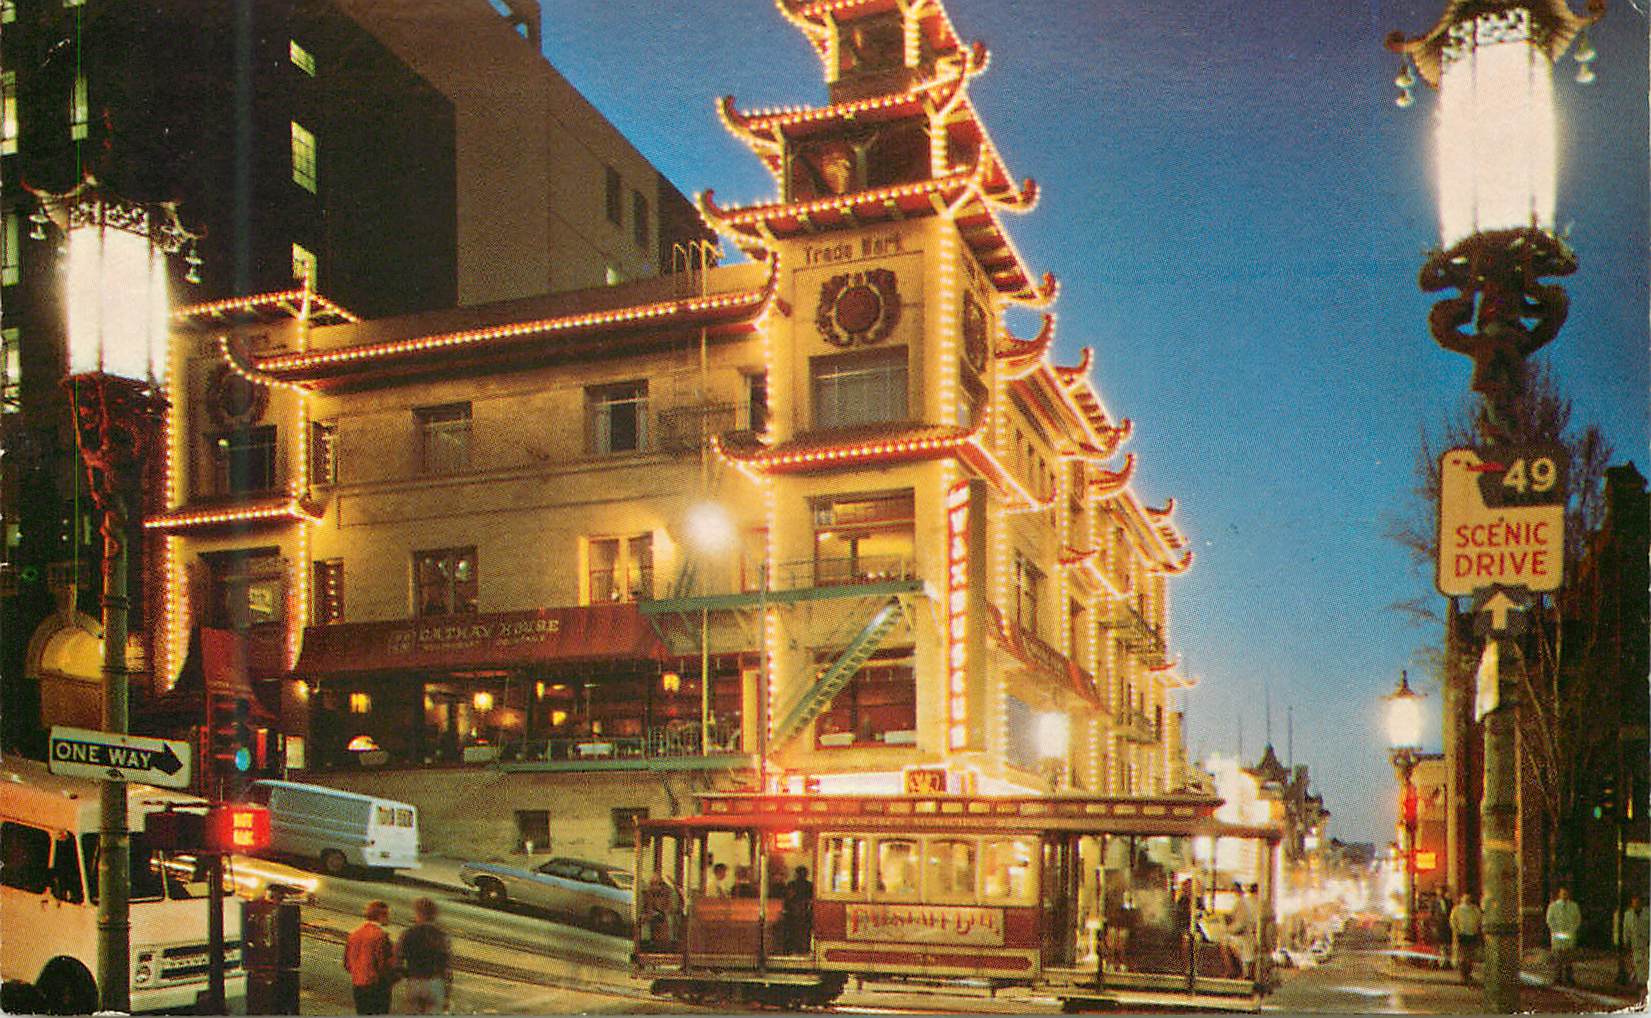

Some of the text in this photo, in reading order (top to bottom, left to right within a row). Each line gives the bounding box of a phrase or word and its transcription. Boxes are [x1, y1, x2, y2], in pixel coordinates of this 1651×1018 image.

[1502, 457, 1557, 494] 49
[1455, 521, 1548, 548] SCENIC
[1455, 550, 1548, 577] DRIVE
[56, 742, 151, 769] ONE WAY
